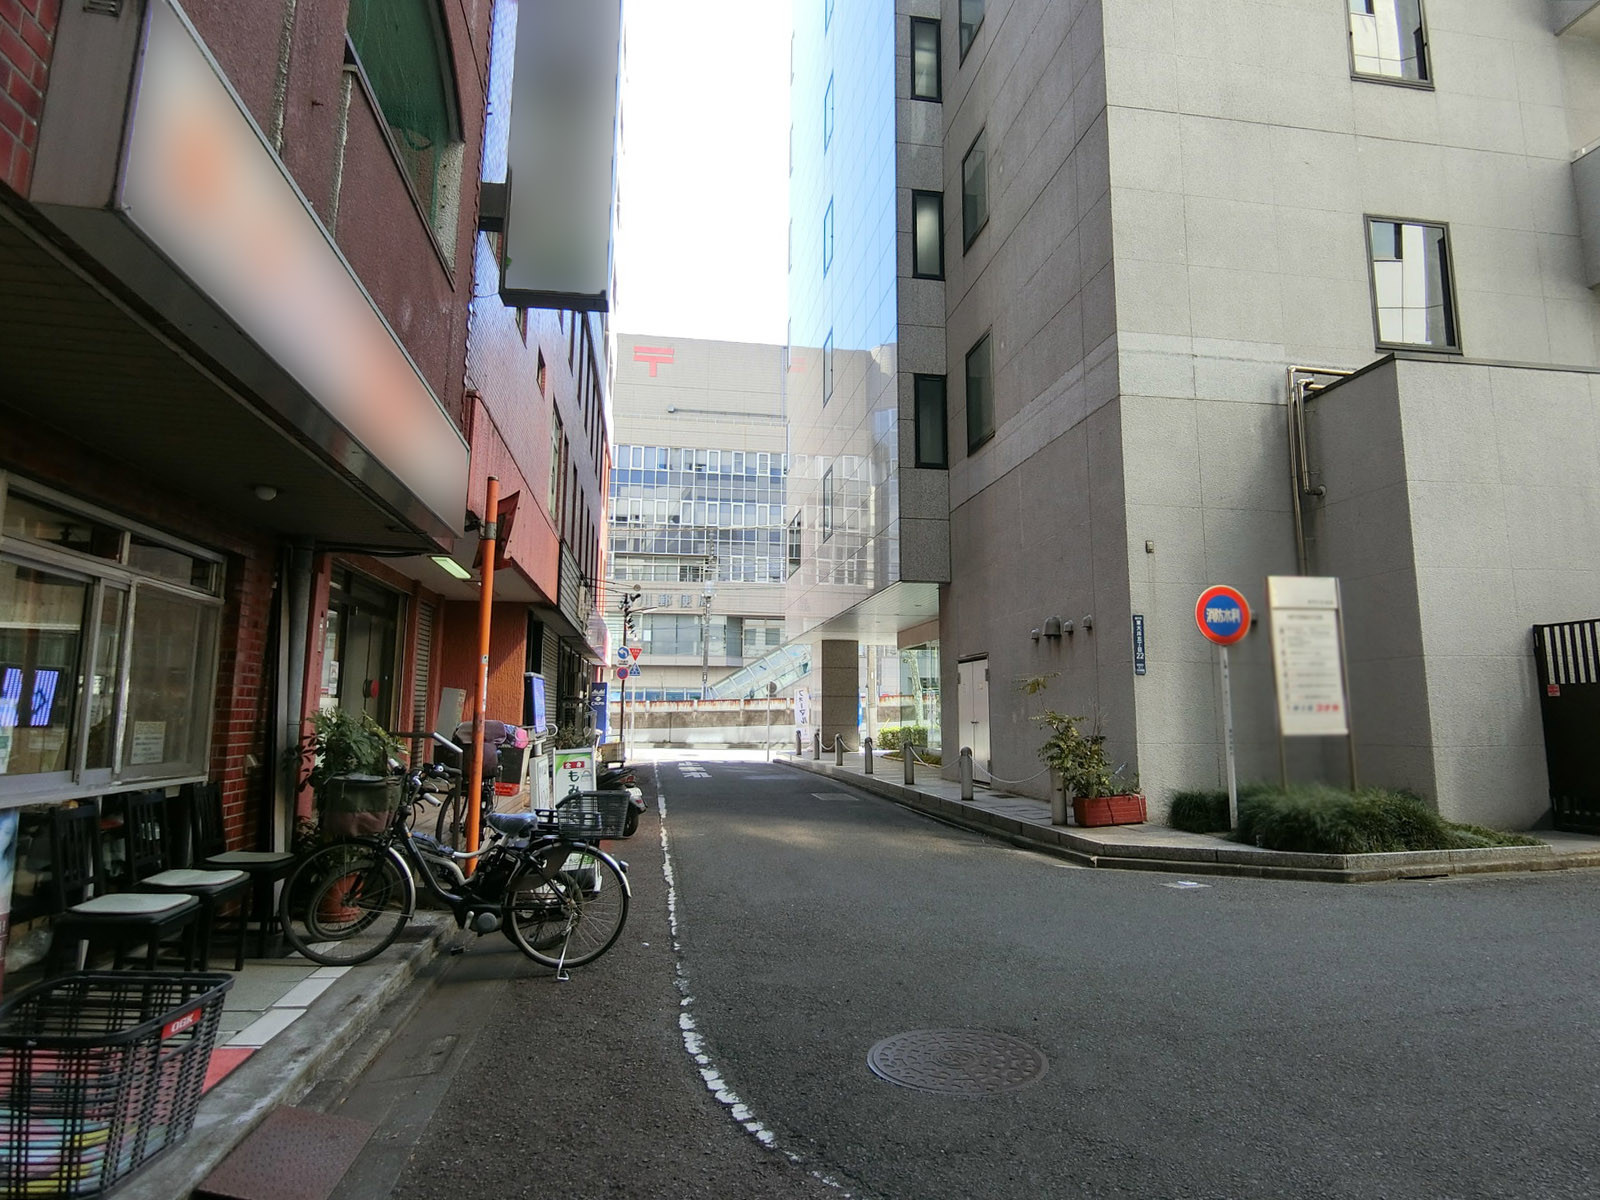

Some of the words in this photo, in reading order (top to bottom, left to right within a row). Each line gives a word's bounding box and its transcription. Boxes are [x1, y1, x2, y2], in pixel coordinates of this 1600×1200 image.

[1206, 608, 1241, 623] 消防水利
[171, 1012, 194, 1033] OGK
